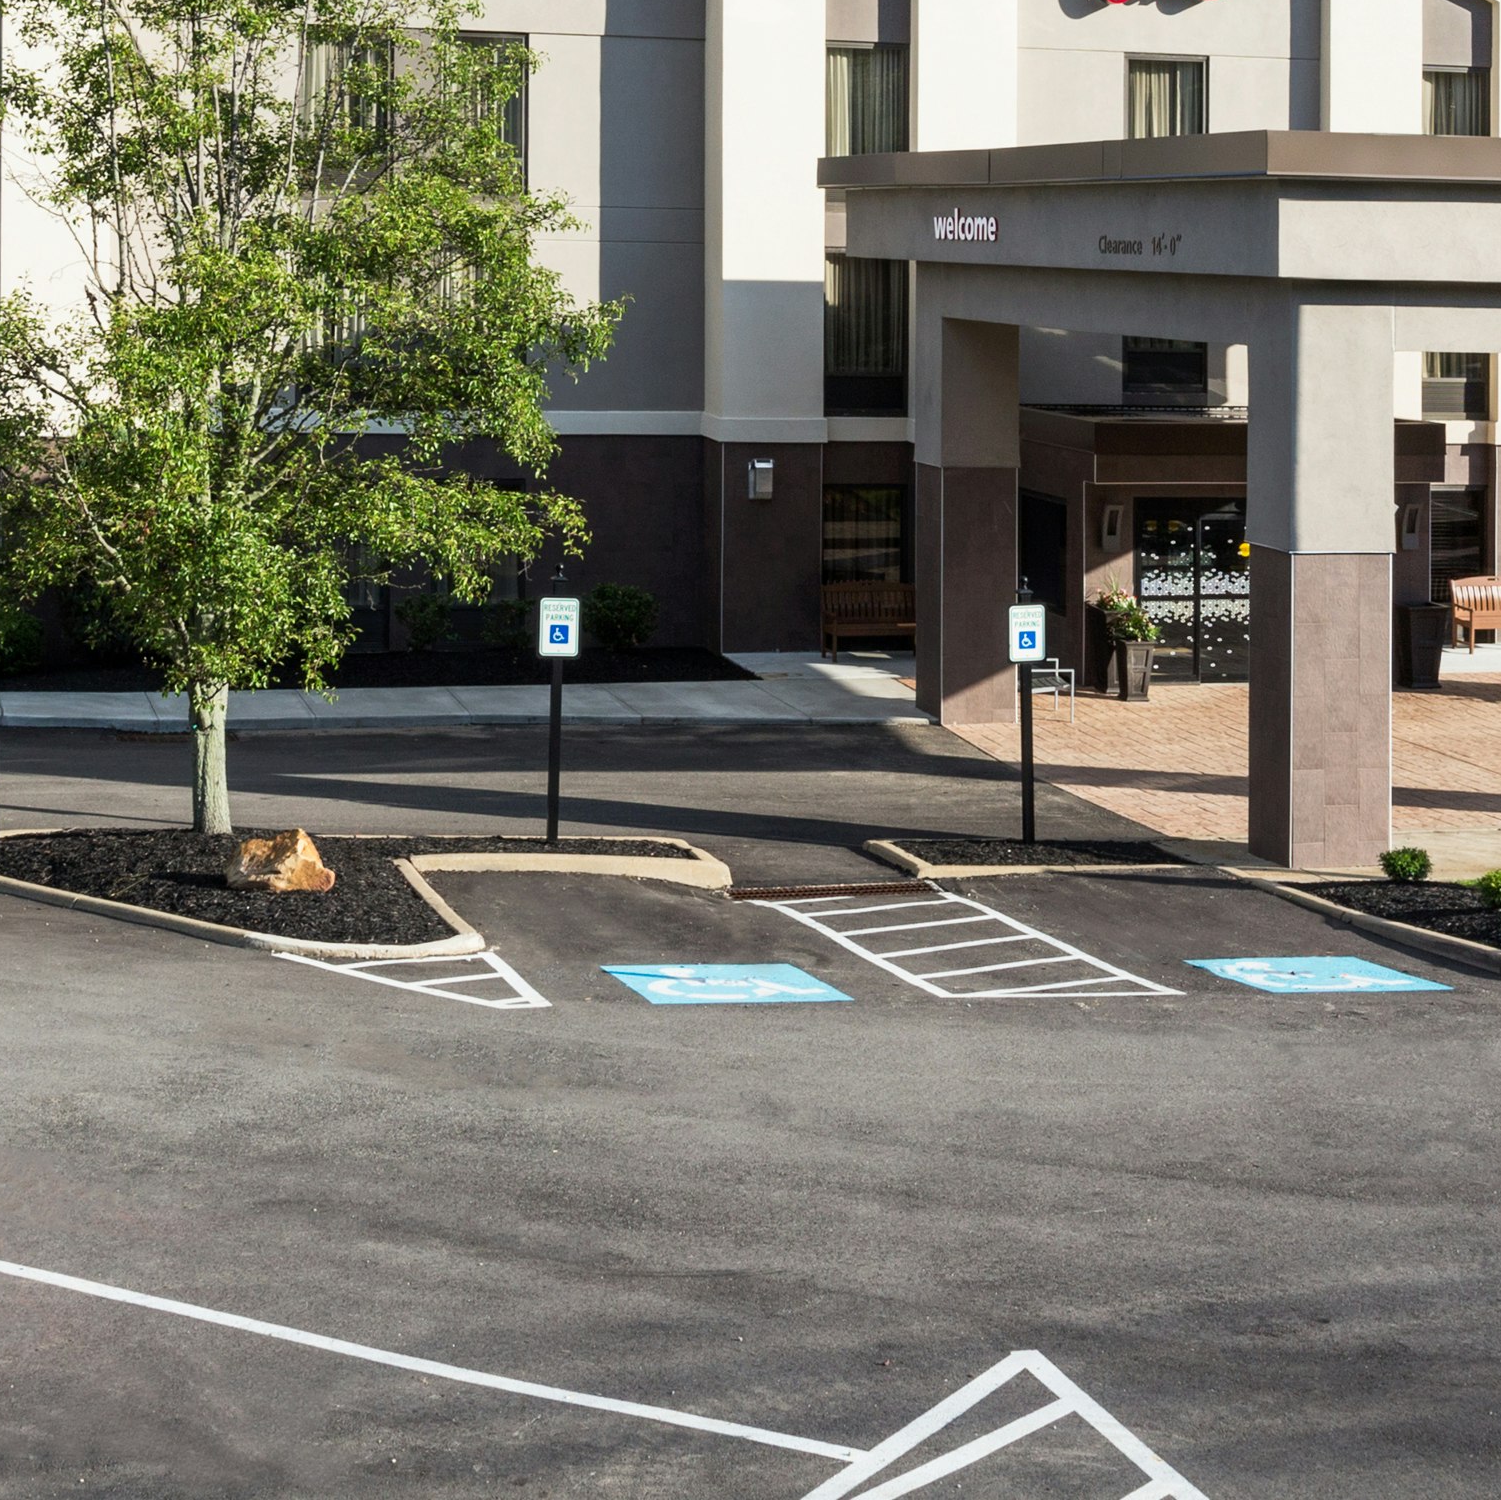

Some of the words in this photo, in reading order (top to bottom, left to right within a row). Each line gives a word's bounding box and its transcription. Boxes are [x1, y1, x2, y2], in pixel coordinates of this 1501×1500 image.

[933, 208, 998, 242] welcome
[1098, 234, 1143, 256] Clearance
[543, 604, 576, 612] RESERVED
[545, 613, 574, 622] PARKING
